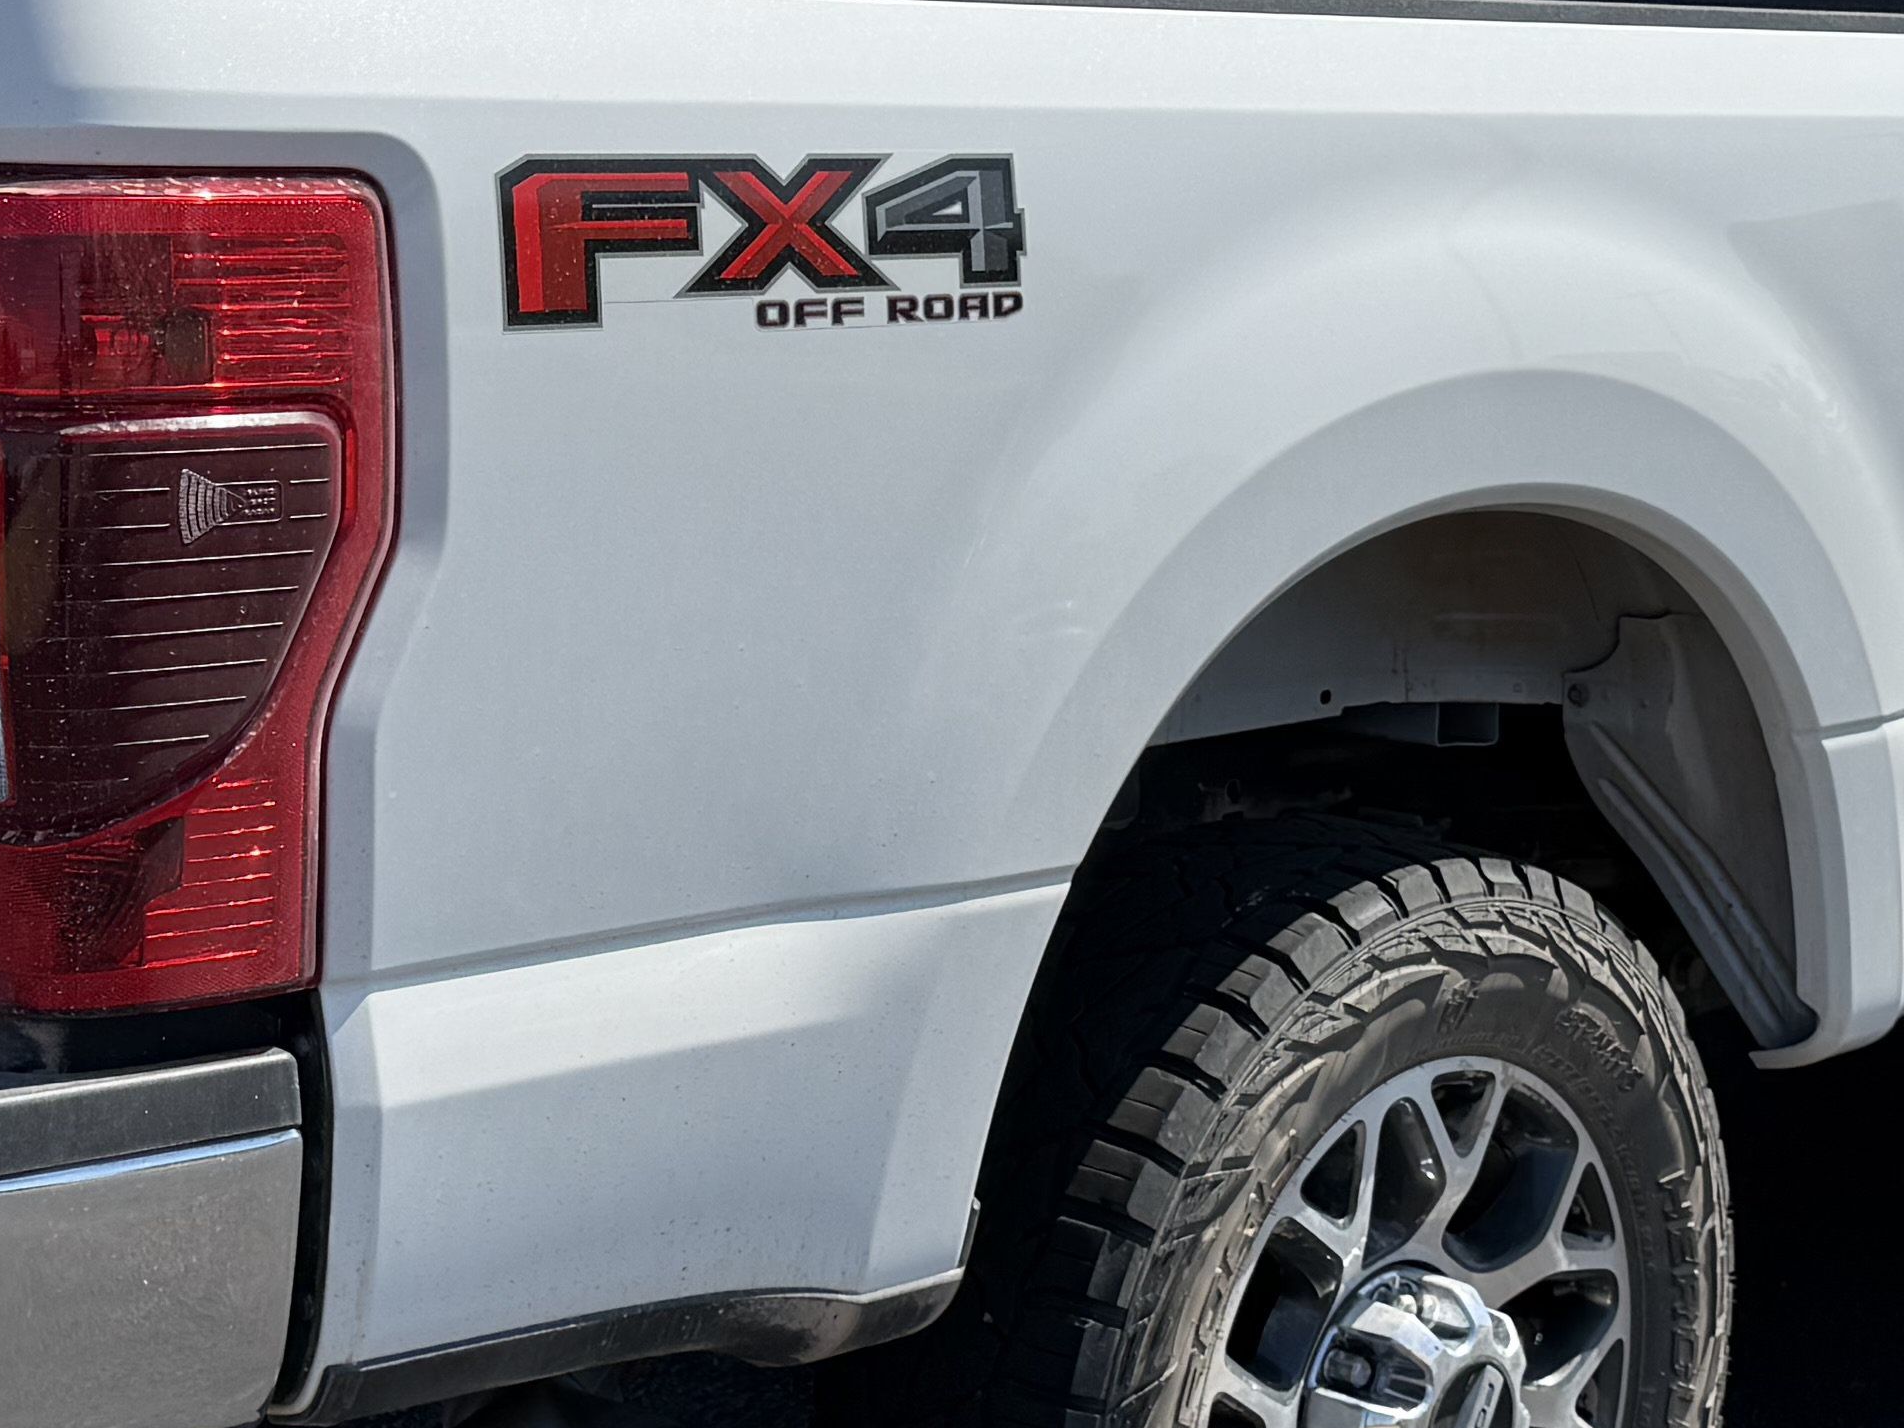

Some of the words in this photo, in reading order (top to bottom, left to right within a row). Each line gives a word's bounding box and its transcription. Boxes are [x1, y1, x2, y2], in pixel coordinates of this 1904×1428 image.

[496, 153, 1026, 331] FX4
[756, 296, 865, 328] OFF
[886, 291, 1023, 324] ROAD
